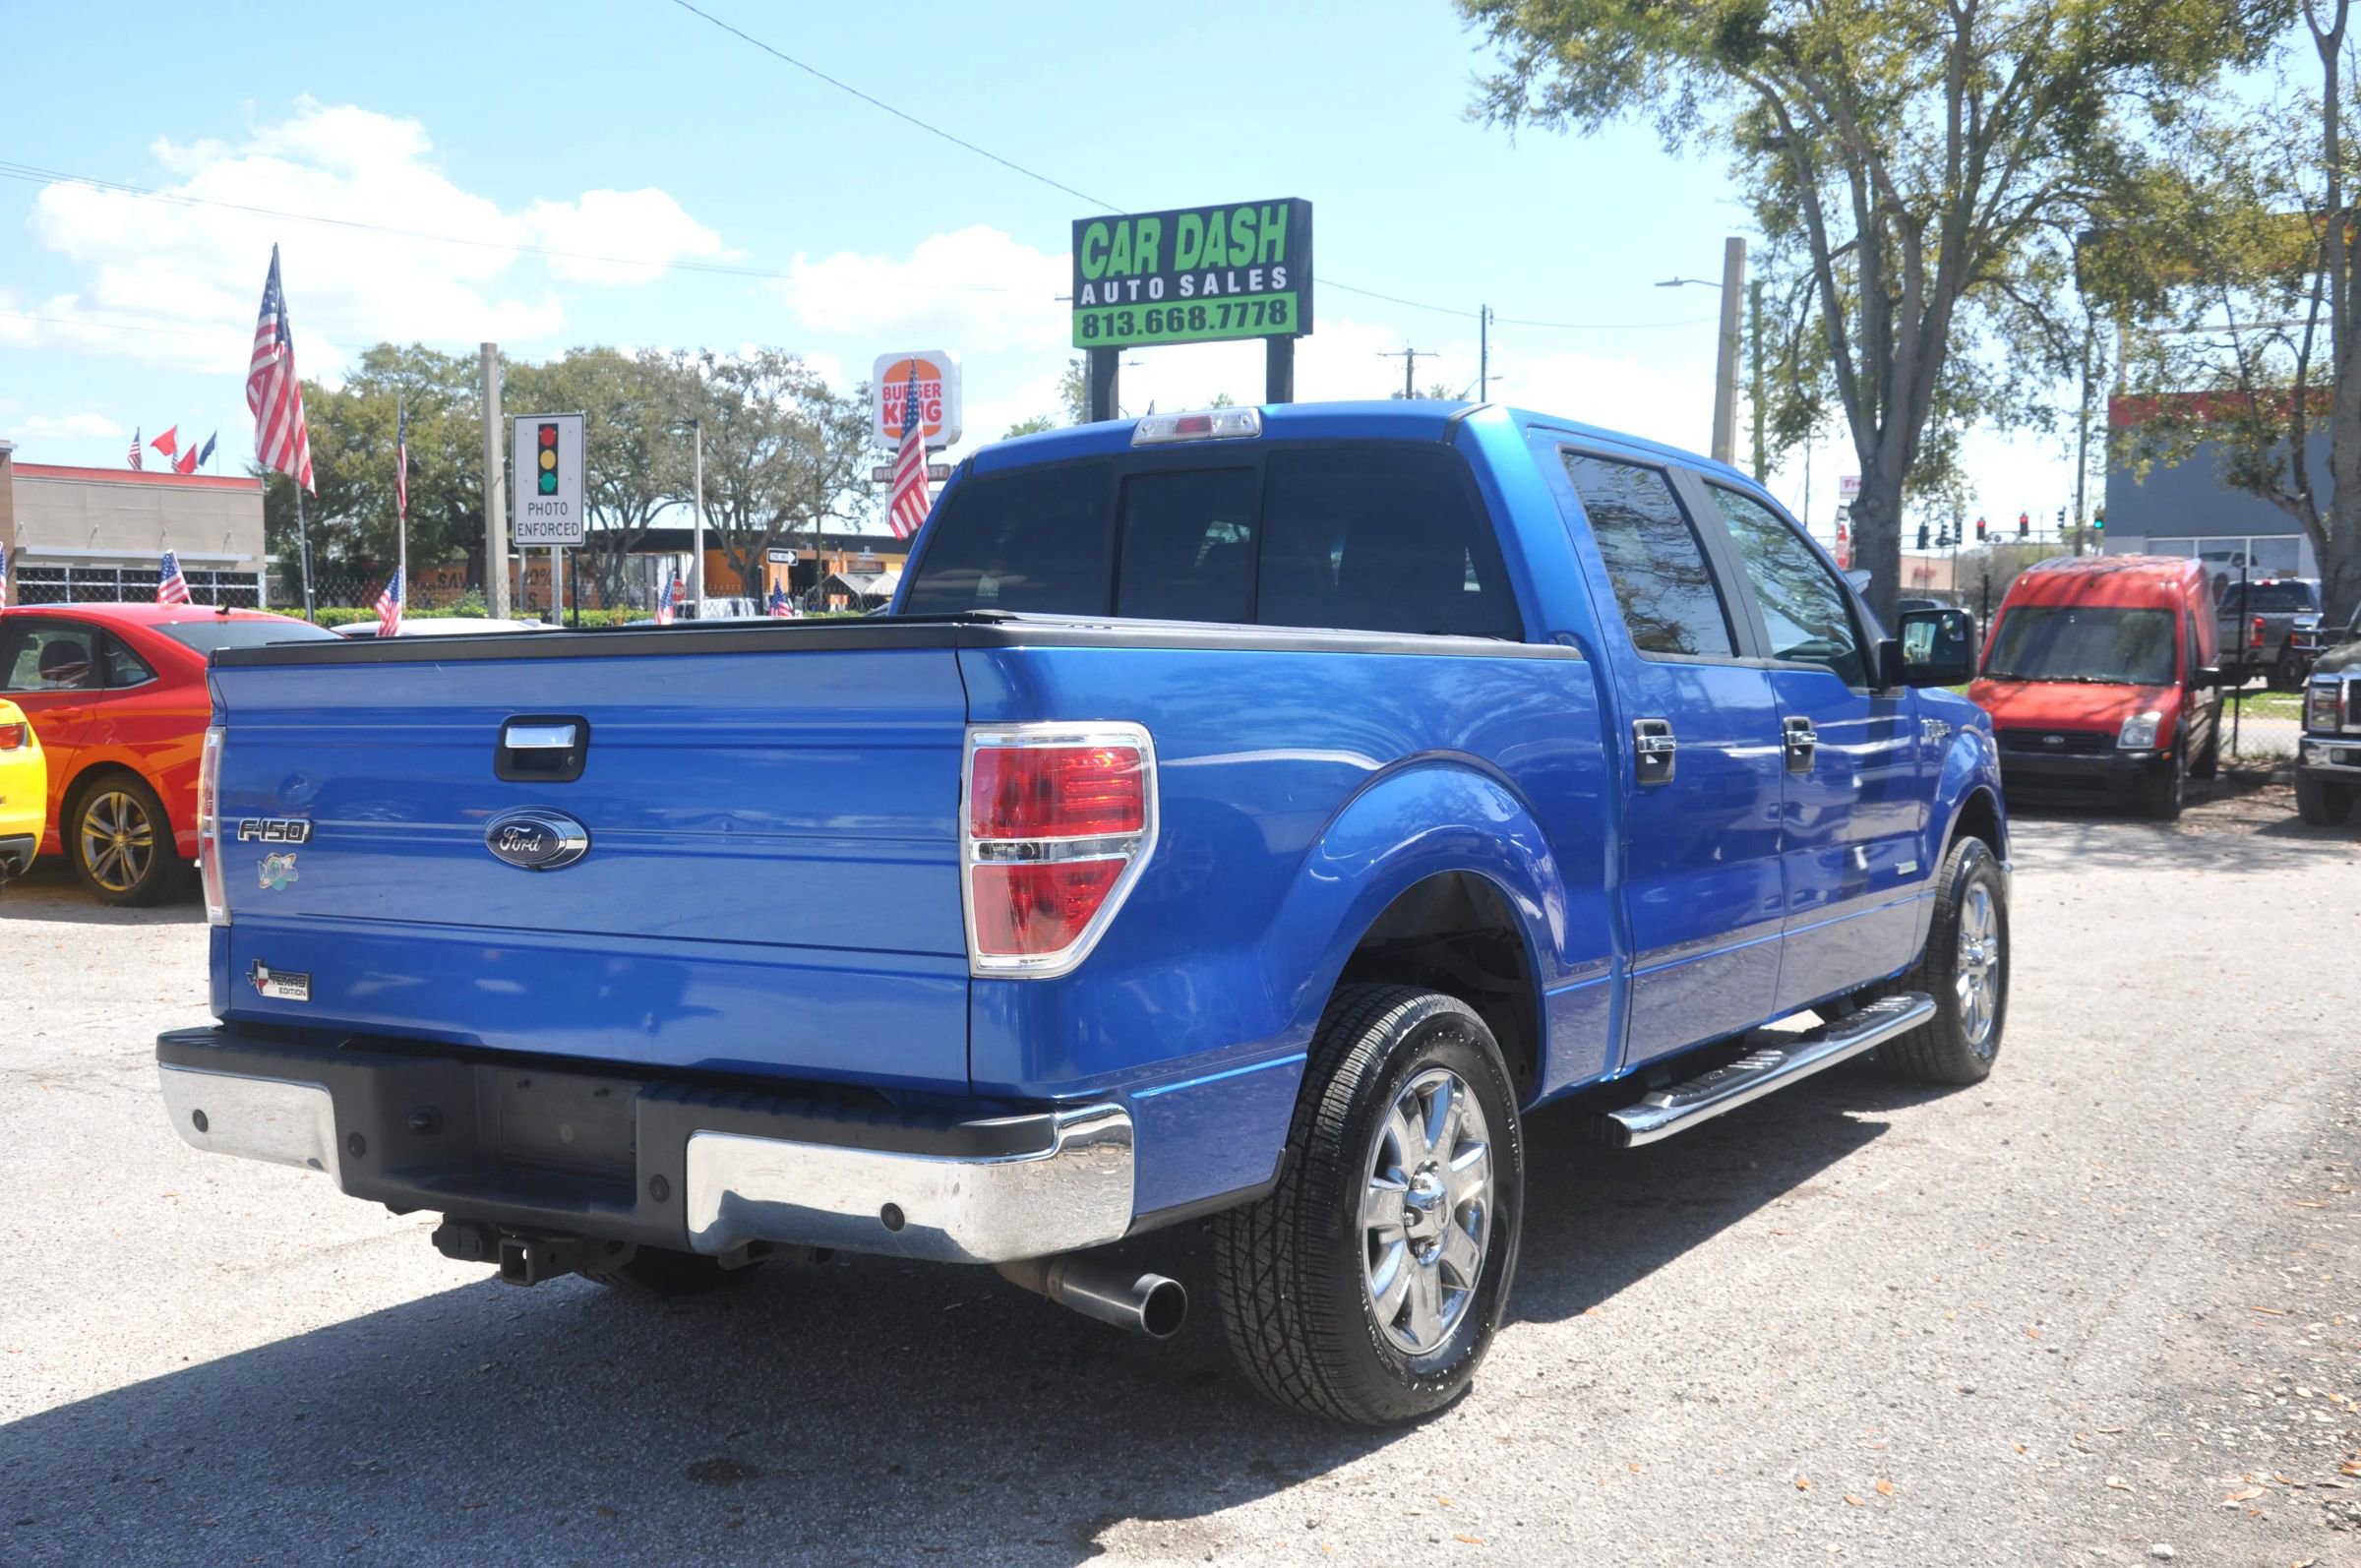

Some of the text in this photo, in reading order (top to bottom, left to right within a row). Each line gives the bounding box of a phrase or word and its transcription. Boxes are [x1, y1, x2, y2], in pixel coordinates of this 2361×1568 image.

[1081, 204, 1289, 280] CAR DASH
[1080, 267, 1287, 305] AUTO SALES
[1082, 298, 1289, 338] 813.668.7778
[882, 399, 942, 425] KIG
[527, 502, 568, 515] PHOTO
[517, 522, 579, 536] ENFORCED
[238, 817, 310, 843] F-150
[500, 826, 542, 852] Ford
[271, 974, 307, 989] TEXAS
[278, 987, 306, 996] EDITION
